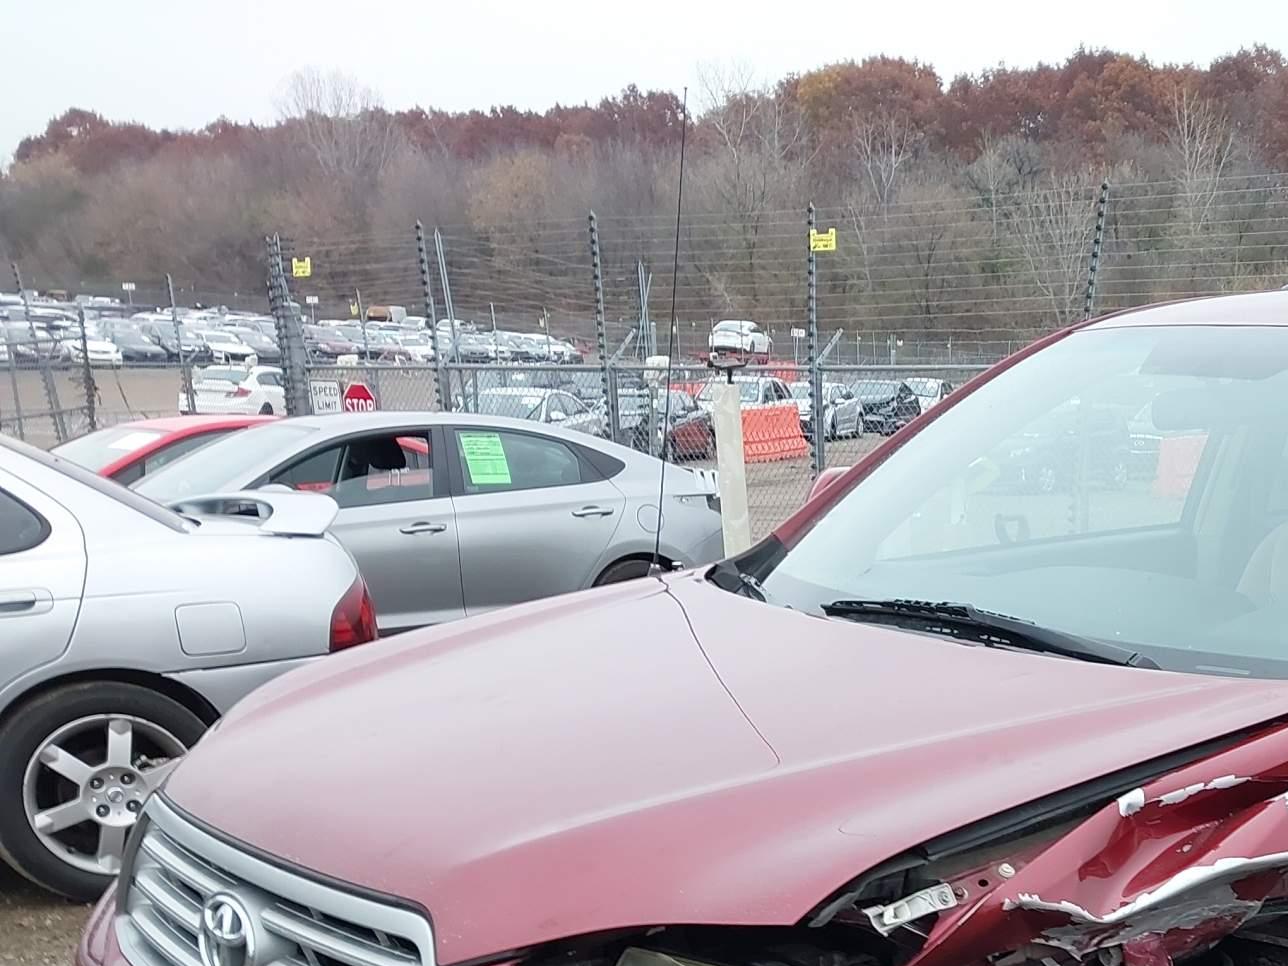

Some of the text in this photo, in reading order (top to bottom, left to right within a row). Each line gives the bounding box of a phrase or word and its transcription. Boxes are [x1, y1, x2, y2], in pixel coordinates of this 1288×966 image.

[313, 385, 338, 397] SPEED
[317, 400, 337, 410] LIMIT
[345, 398, 374, 413] STOP
